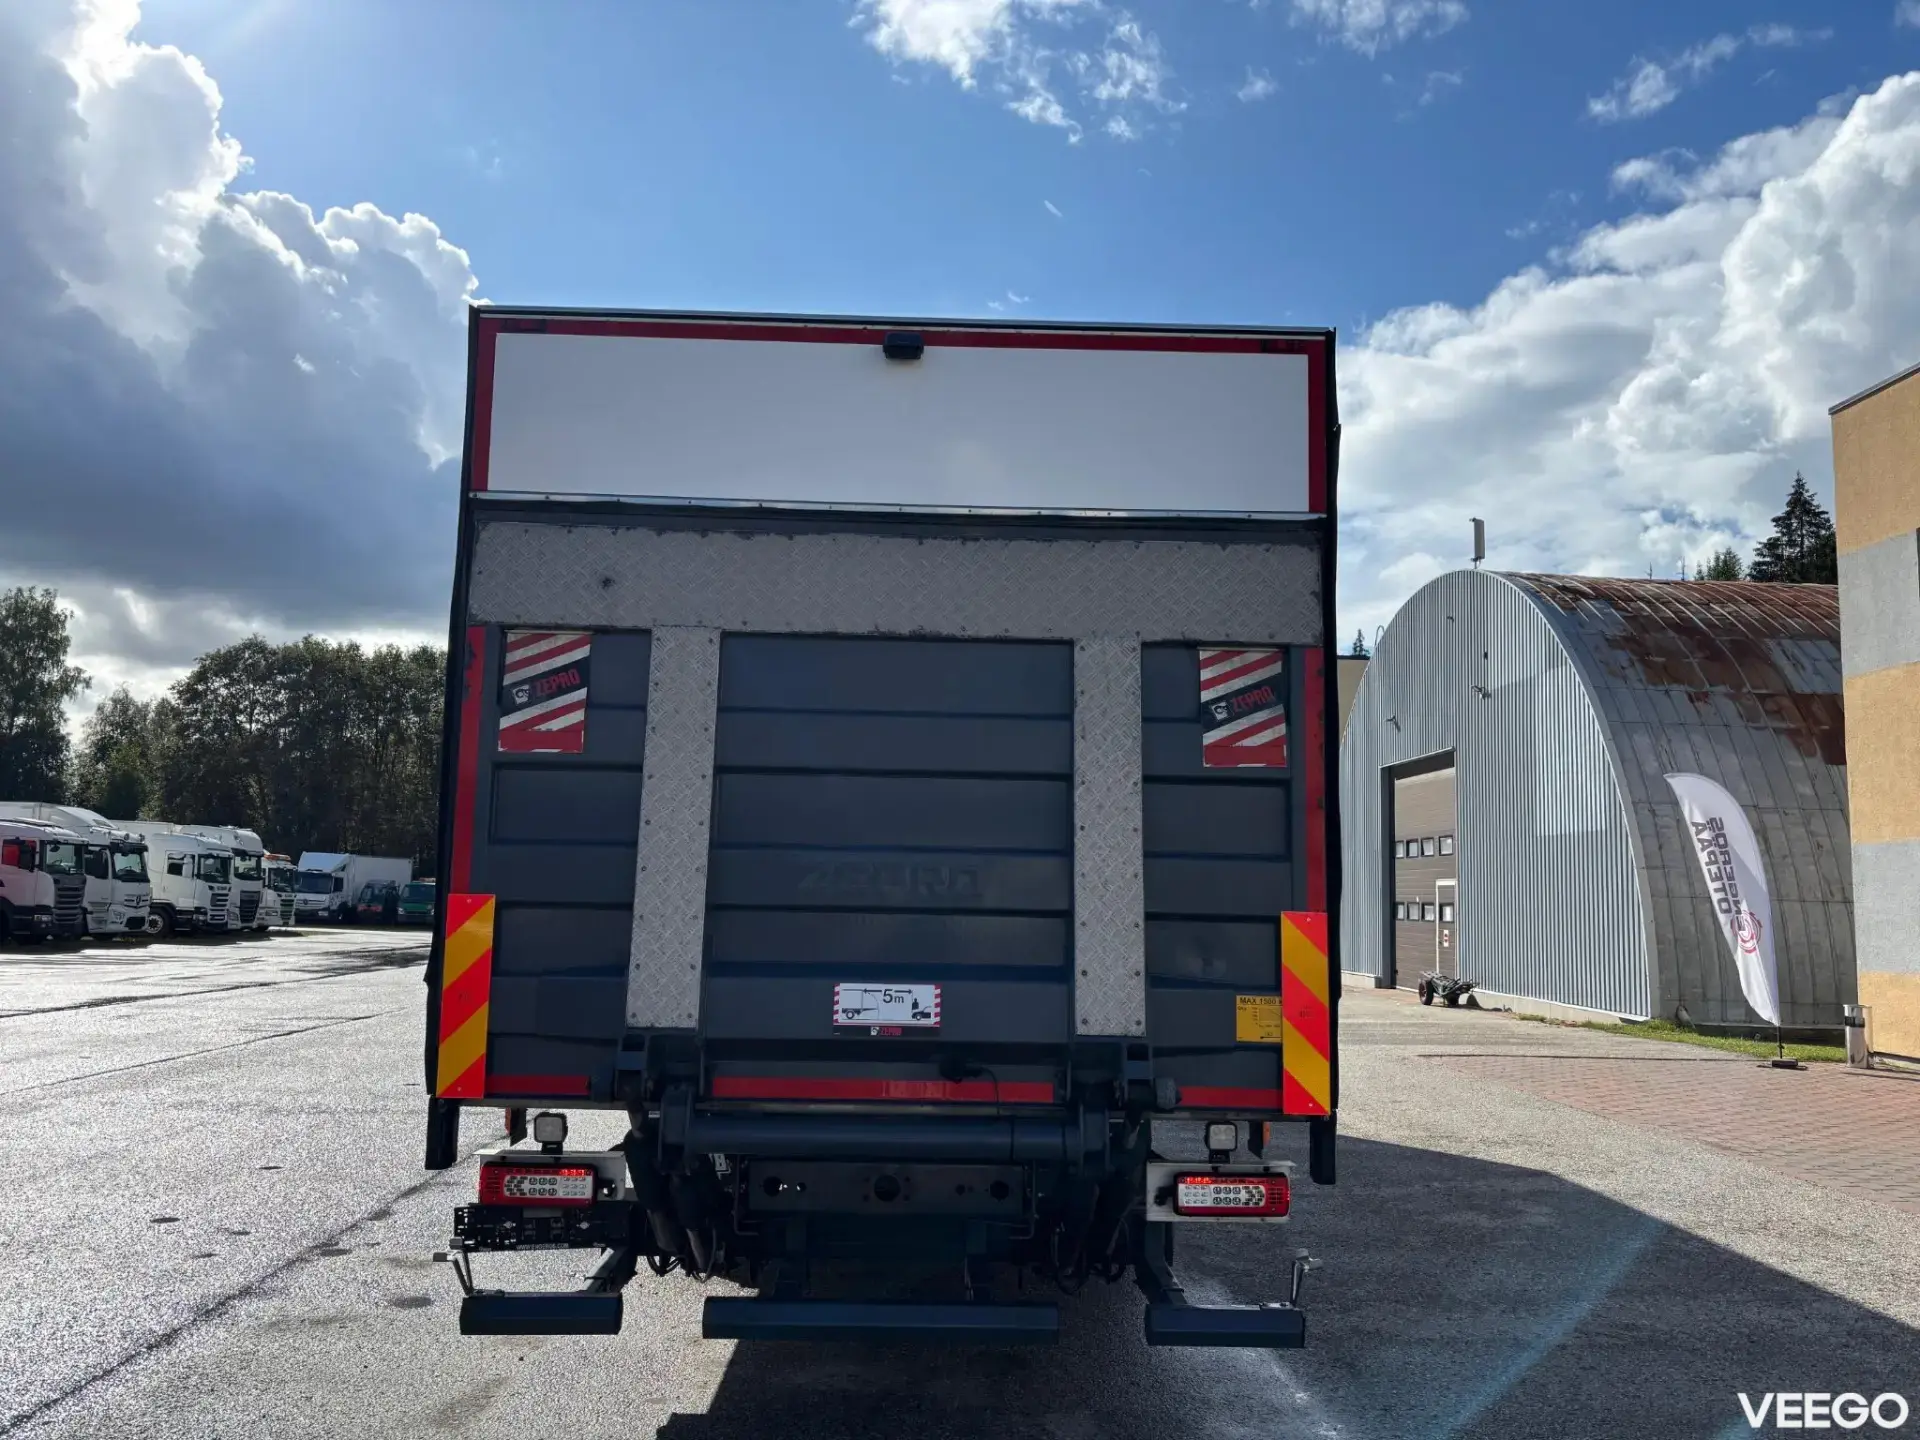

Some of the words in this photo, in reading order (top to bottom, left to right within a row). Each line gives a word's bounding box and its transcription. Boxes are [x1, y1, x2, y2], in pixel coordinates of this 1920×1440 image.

[534, 668, 581, 697] ZEPRO
[1231, 685, 1277, 712] ZEPRO
[1239, 997, 1257, 1005] MAX
